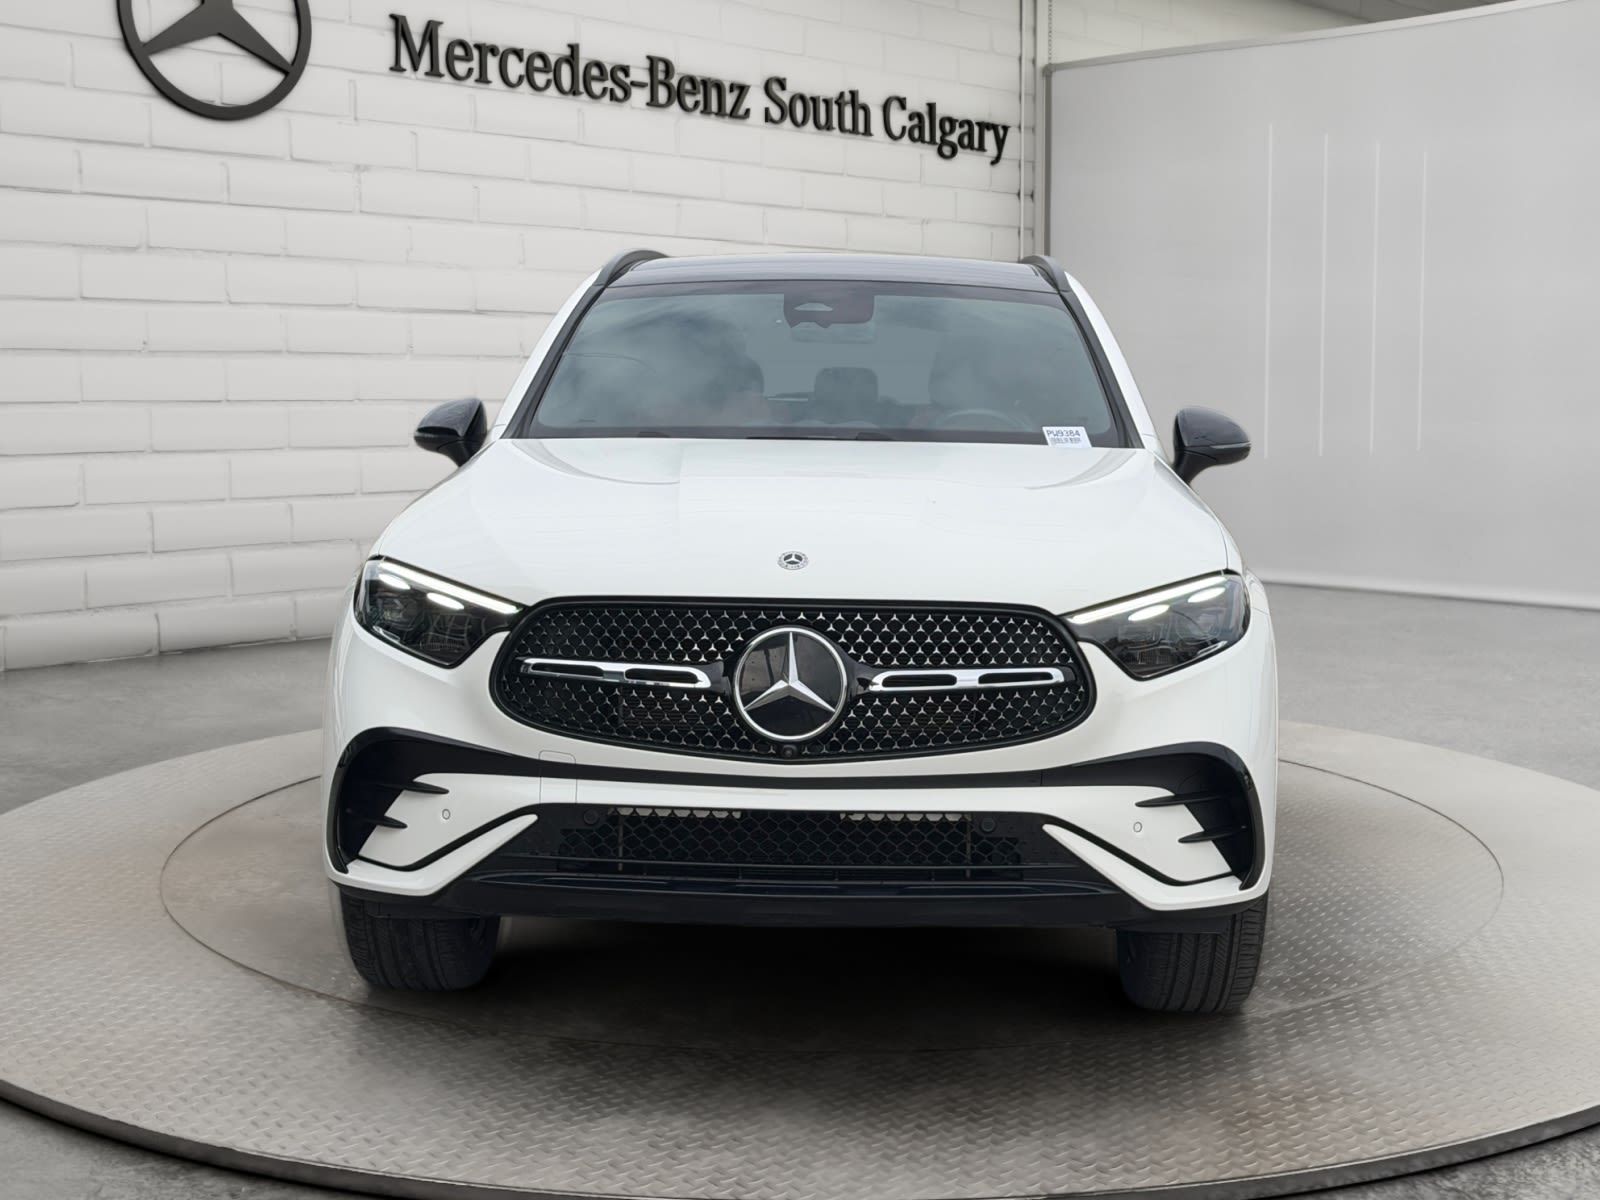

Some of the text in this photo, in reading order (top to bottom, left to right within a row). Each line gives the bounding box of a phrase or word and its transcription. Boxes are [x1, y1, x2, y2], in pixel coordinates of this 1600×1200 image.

[388, 13, 1011, 167] Mercedes-Benz South Calgary
